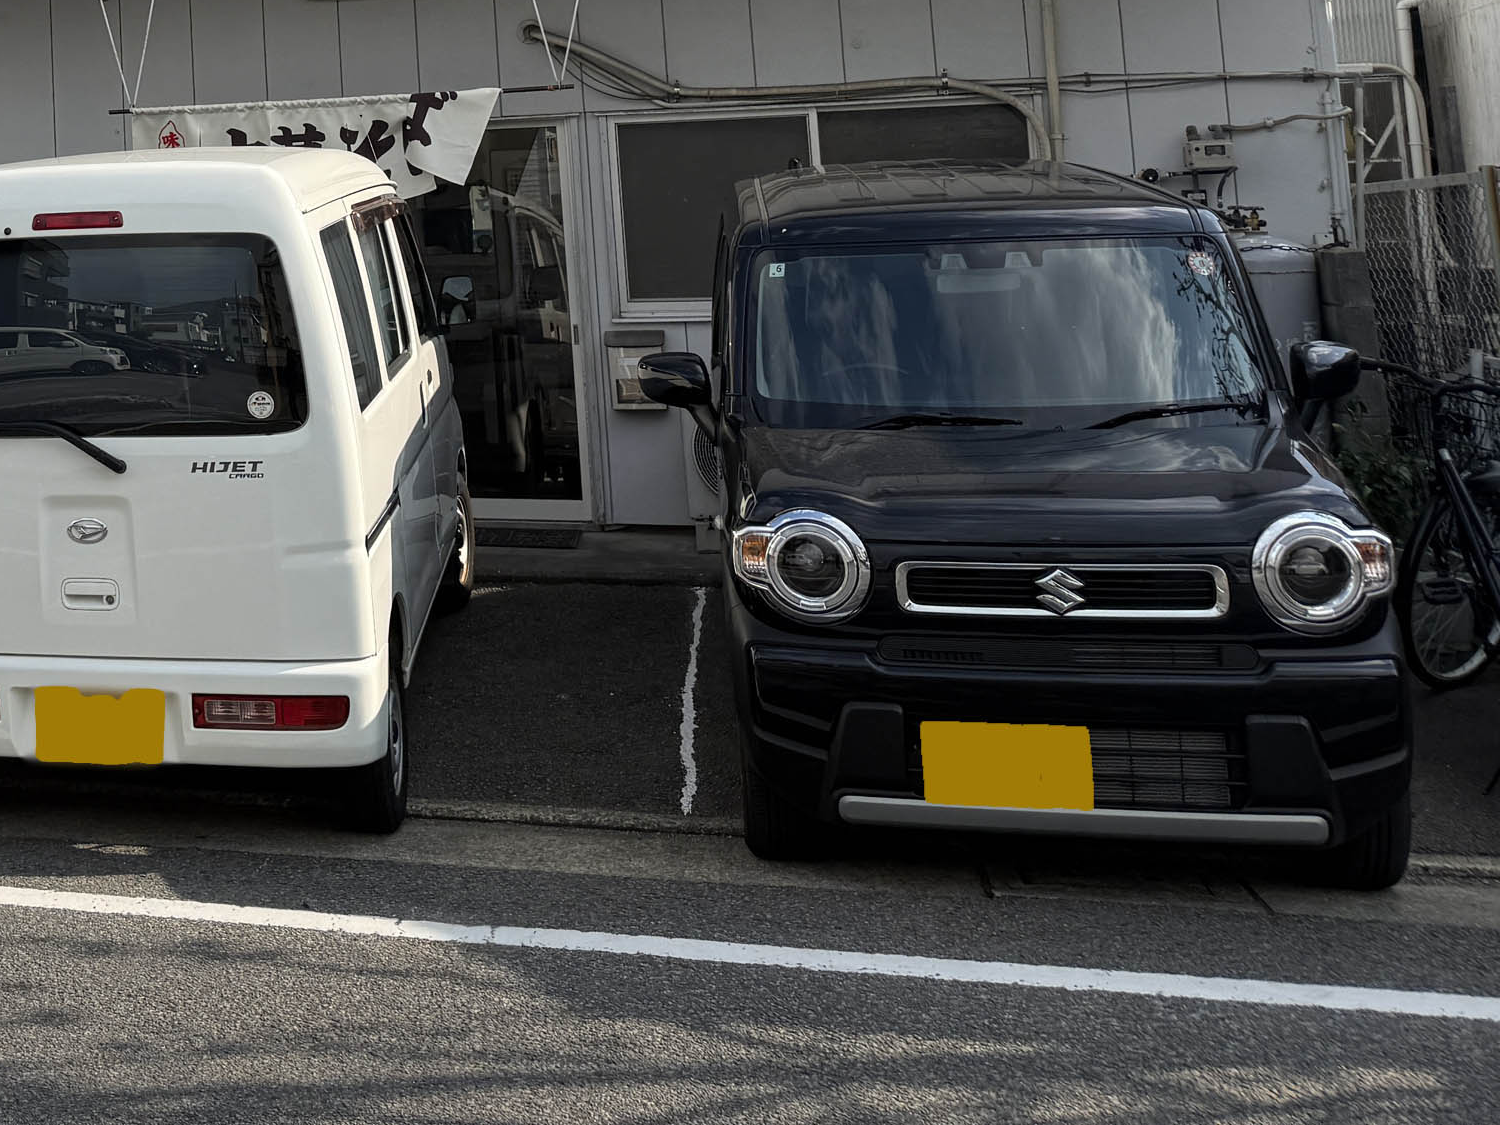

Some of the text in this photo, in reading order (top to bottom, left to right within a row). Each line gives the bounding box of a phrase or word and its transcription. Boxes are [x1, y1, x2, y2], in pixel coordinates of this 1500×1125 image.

[162, 131, 181, 149] 味
[191, 460, 264, 474] HIJET
[229, 472, 265, 480] CARGO
